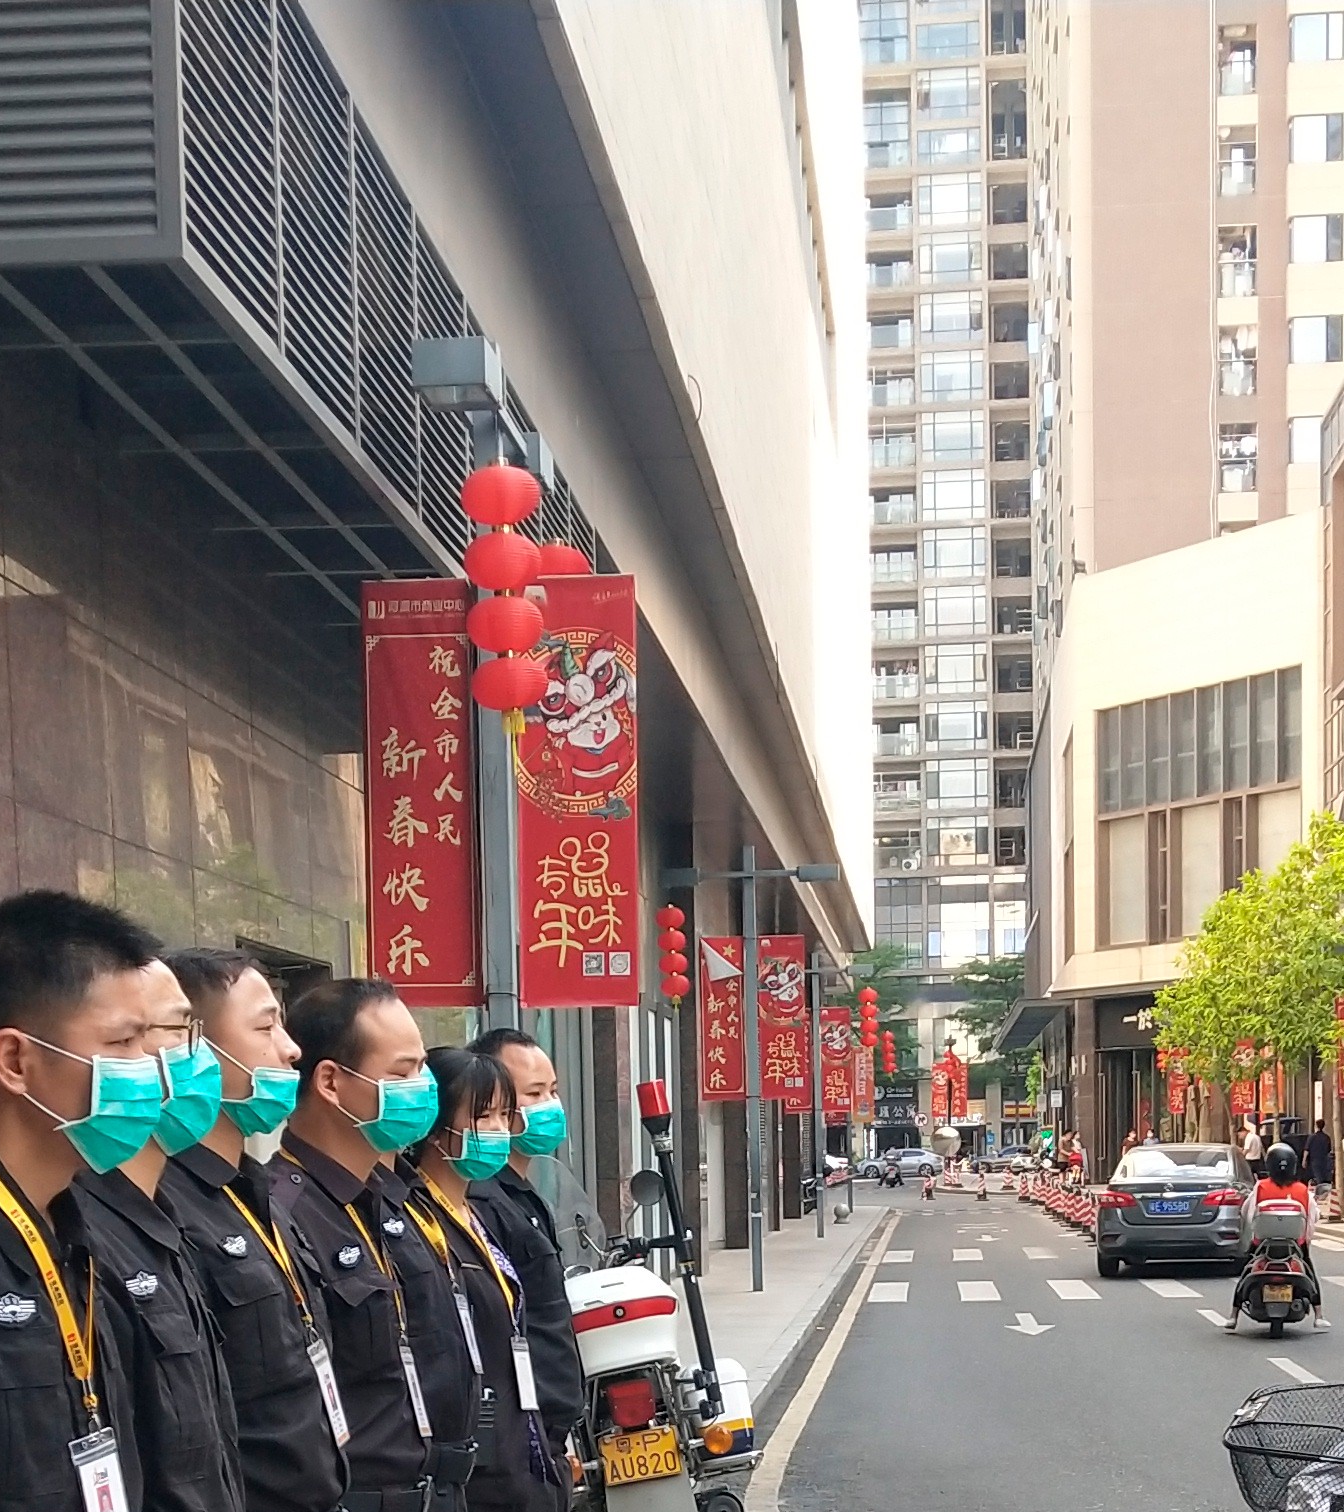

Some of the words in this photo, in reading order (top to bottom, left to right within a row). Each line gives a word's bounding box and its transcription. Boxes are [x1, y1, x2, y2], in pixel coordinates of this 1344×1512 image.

[429, 645, 463, 845] 祝全市人民
[381, 727, 430, 976] 新春快乐
[529, 897, 623, 967] 年味
[610, 1450, 677, 1482] AU820
